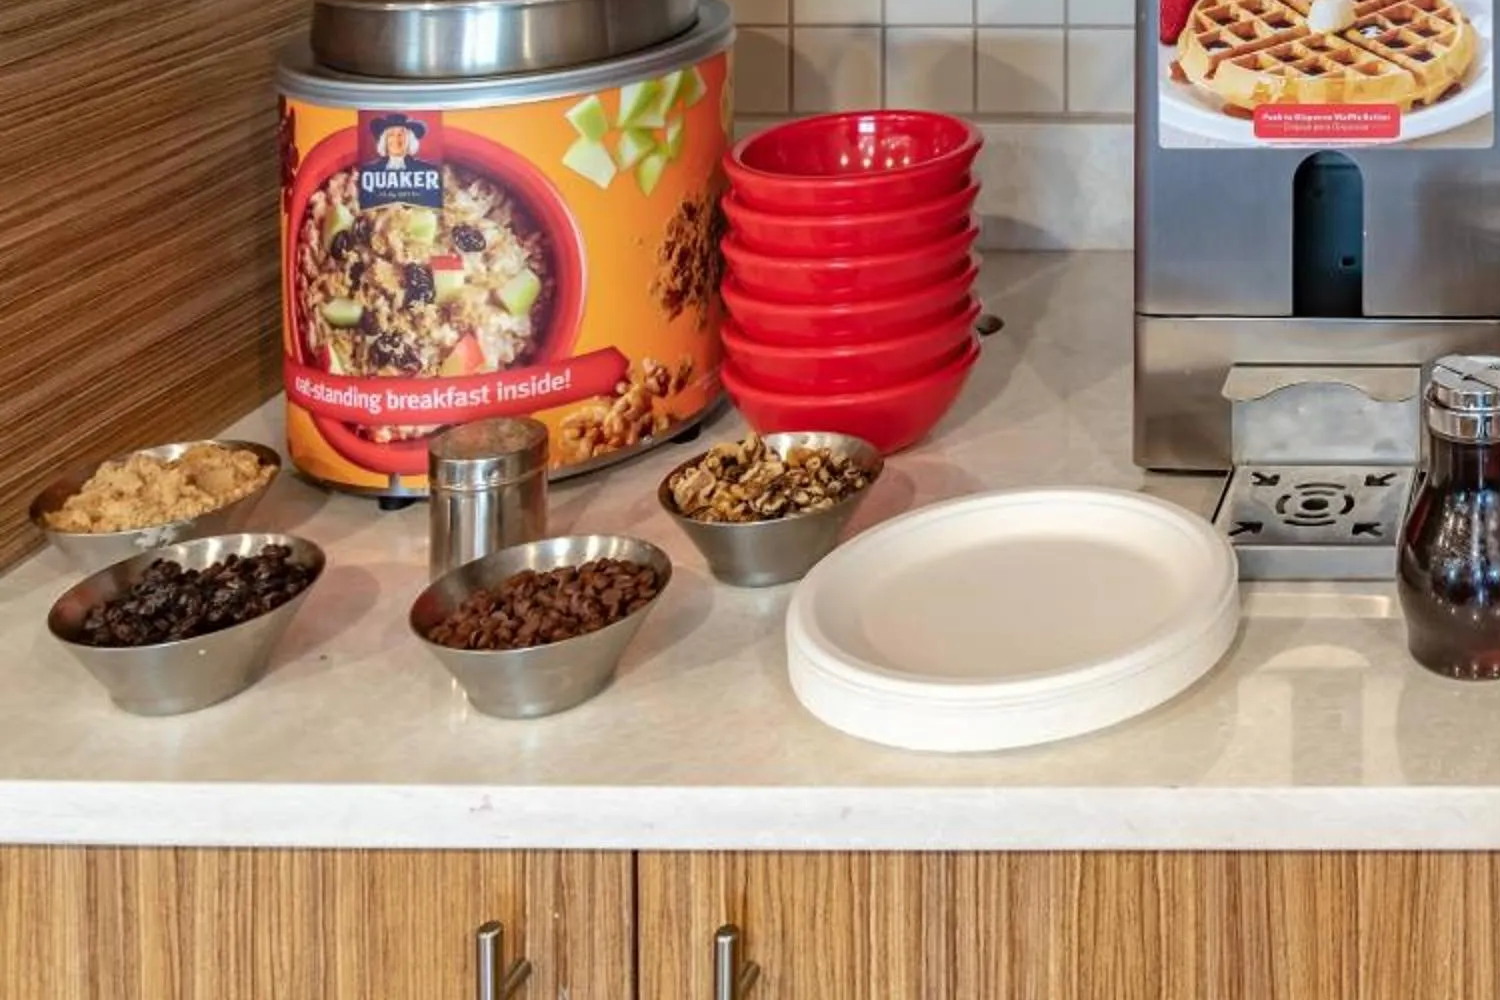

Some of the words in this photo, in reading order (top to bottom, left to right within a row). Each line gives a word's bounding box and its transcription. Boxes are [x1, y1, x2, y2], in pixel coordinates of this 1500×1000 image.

[362, 170, 440, 192] QUAKER
[386, 385, 490, 410] breakfast
[496, 368, 572, 402] inside!
